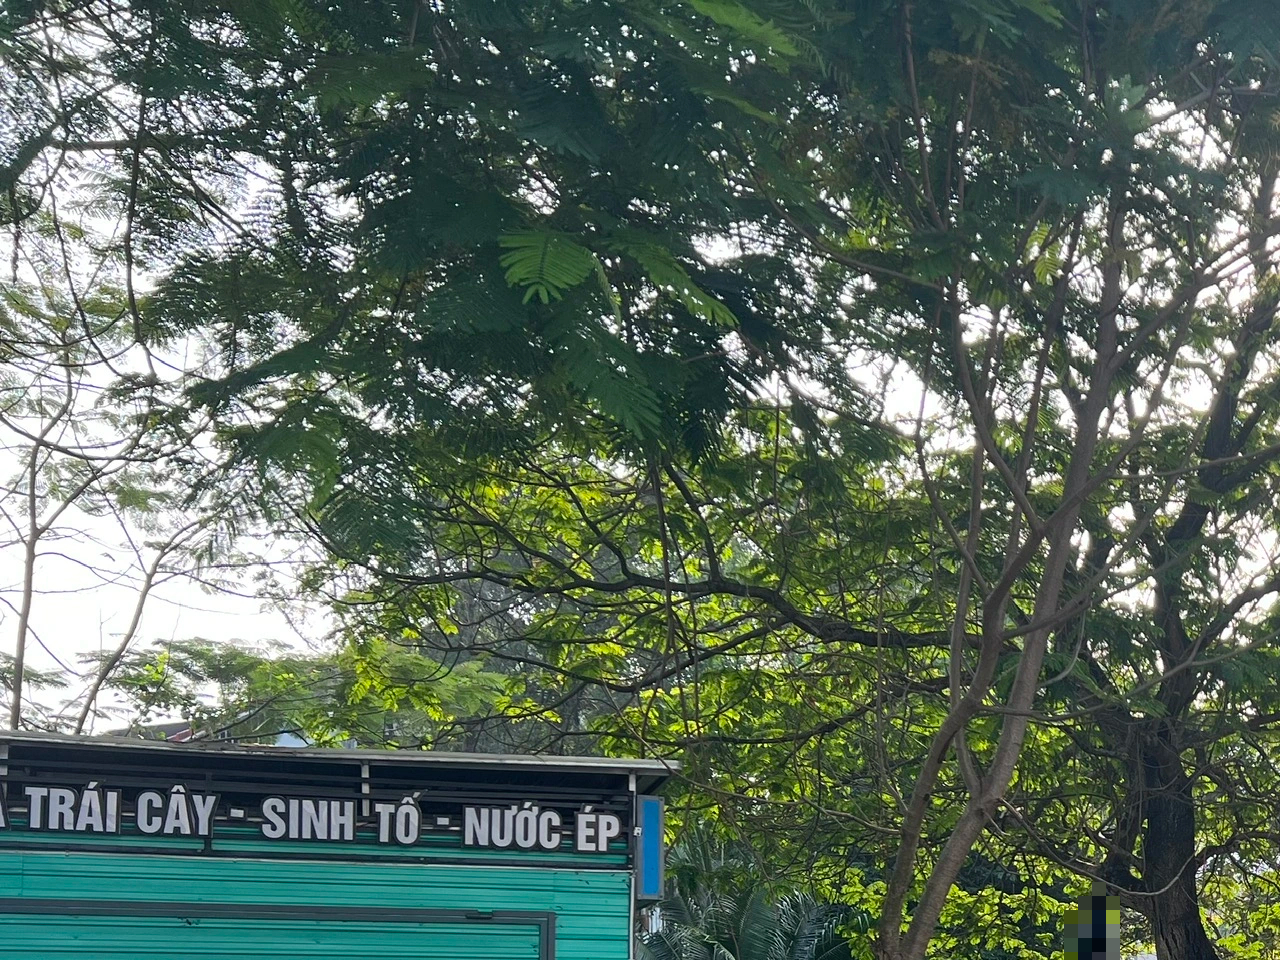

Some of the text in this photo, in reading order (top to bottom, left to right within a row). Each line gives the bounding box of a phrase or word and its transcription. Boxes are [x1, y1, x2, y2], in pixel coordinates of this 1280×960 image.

[25, 781, 118, 833] TRÁI
[137, 785, 217, 836] CÂY
[262, 798, 354, 841] SINH
[375, 791, 422, 844] TỐ
[464, 802, 562, 848] NƯỚC
[577, 804, 621, 851] ÉP
